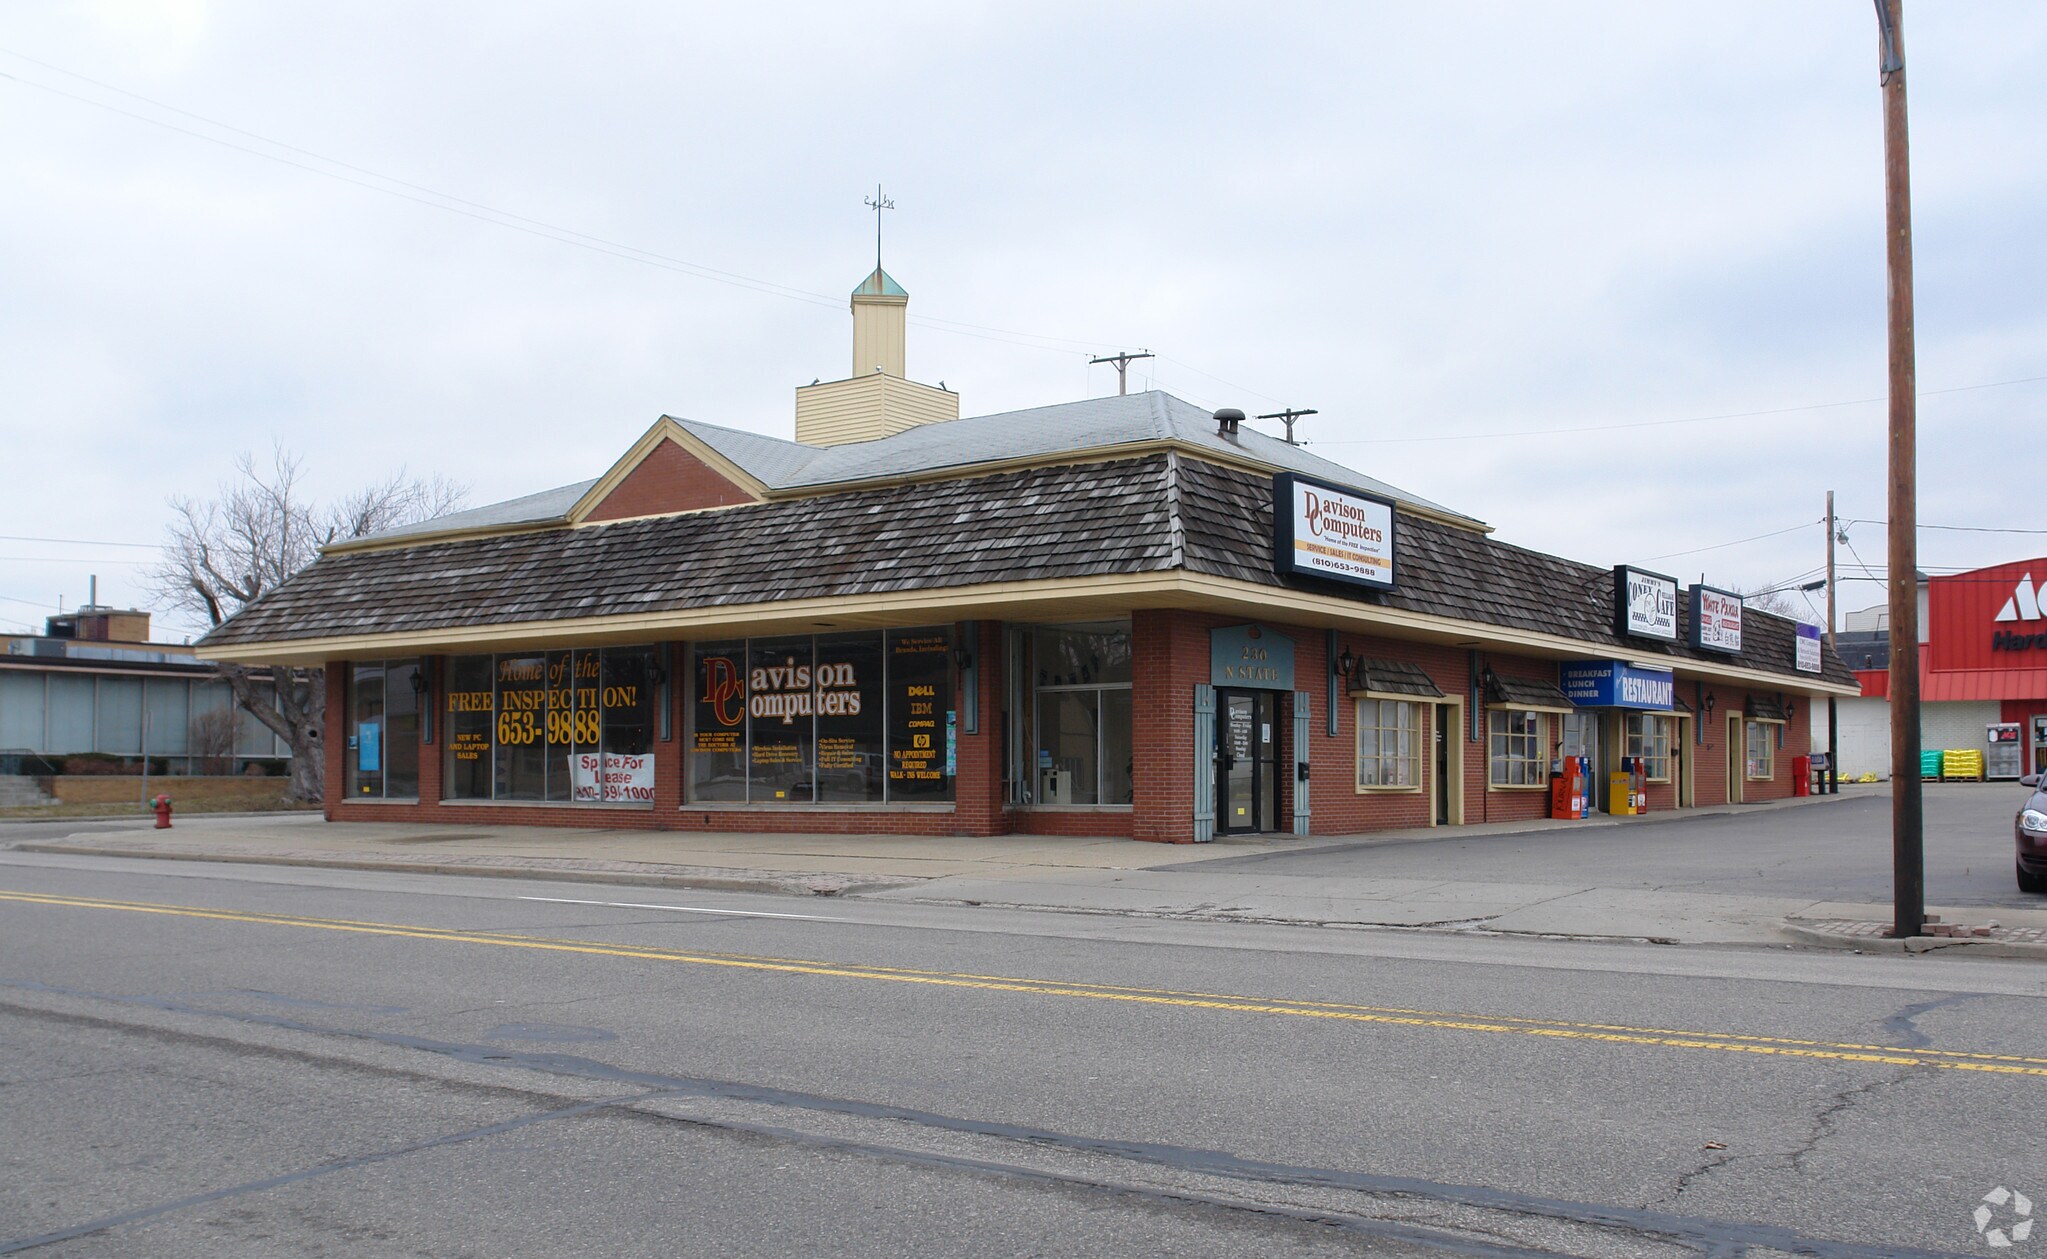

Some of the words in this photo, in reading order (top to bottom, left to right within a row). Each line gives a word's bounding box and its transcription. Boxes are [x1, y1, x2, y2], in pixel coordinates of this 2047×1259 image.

[1304, 491, 1365, 522] Davison
[1310, 508, 1382, 543] Computers
[1306, 543, 1326, 554] SERVICE
[1330, 548, 1344, 558] SALES
[1352, 553, 1381, 566] CONSULTING
[1312, 557, 1376, 576] (810)653-9888
[1628, 582, 1652, 607] CONEY
[1656, 588, 1674, 616] CAFE
[1242, 646, 1267, 662] 230
[498, 660, 543, 682] Home
[550, 654, 570, 688] of
[575, 653, 600, 678] the
[1226, 666, 1234, 680] N
[1238, 666, 1278, 681] STATE
[1568, 670, 1612, 678] BREAKFAST
[448, 692, 494, 712] FREE
[502, 686, 637, 710] INSPECTION!
[908, 686, 935, 697] DELL
[1568, 690, 1599, 698] DINNER
[1622, 676, 1672, 706] RESTAURANT
[911, 702, 932, 714] IBM
[498, 710, 600, 745] 653-9888
[894, 750, 901, 758] NO
[902, 750, 936, 758] APPOINTMENT
[622, 756, 644, 770] For
[902, 761, 927, 769] REQUIRED
[594, 770, 633, 784] Lease
[916, 771, 941, 779] WELCOME
